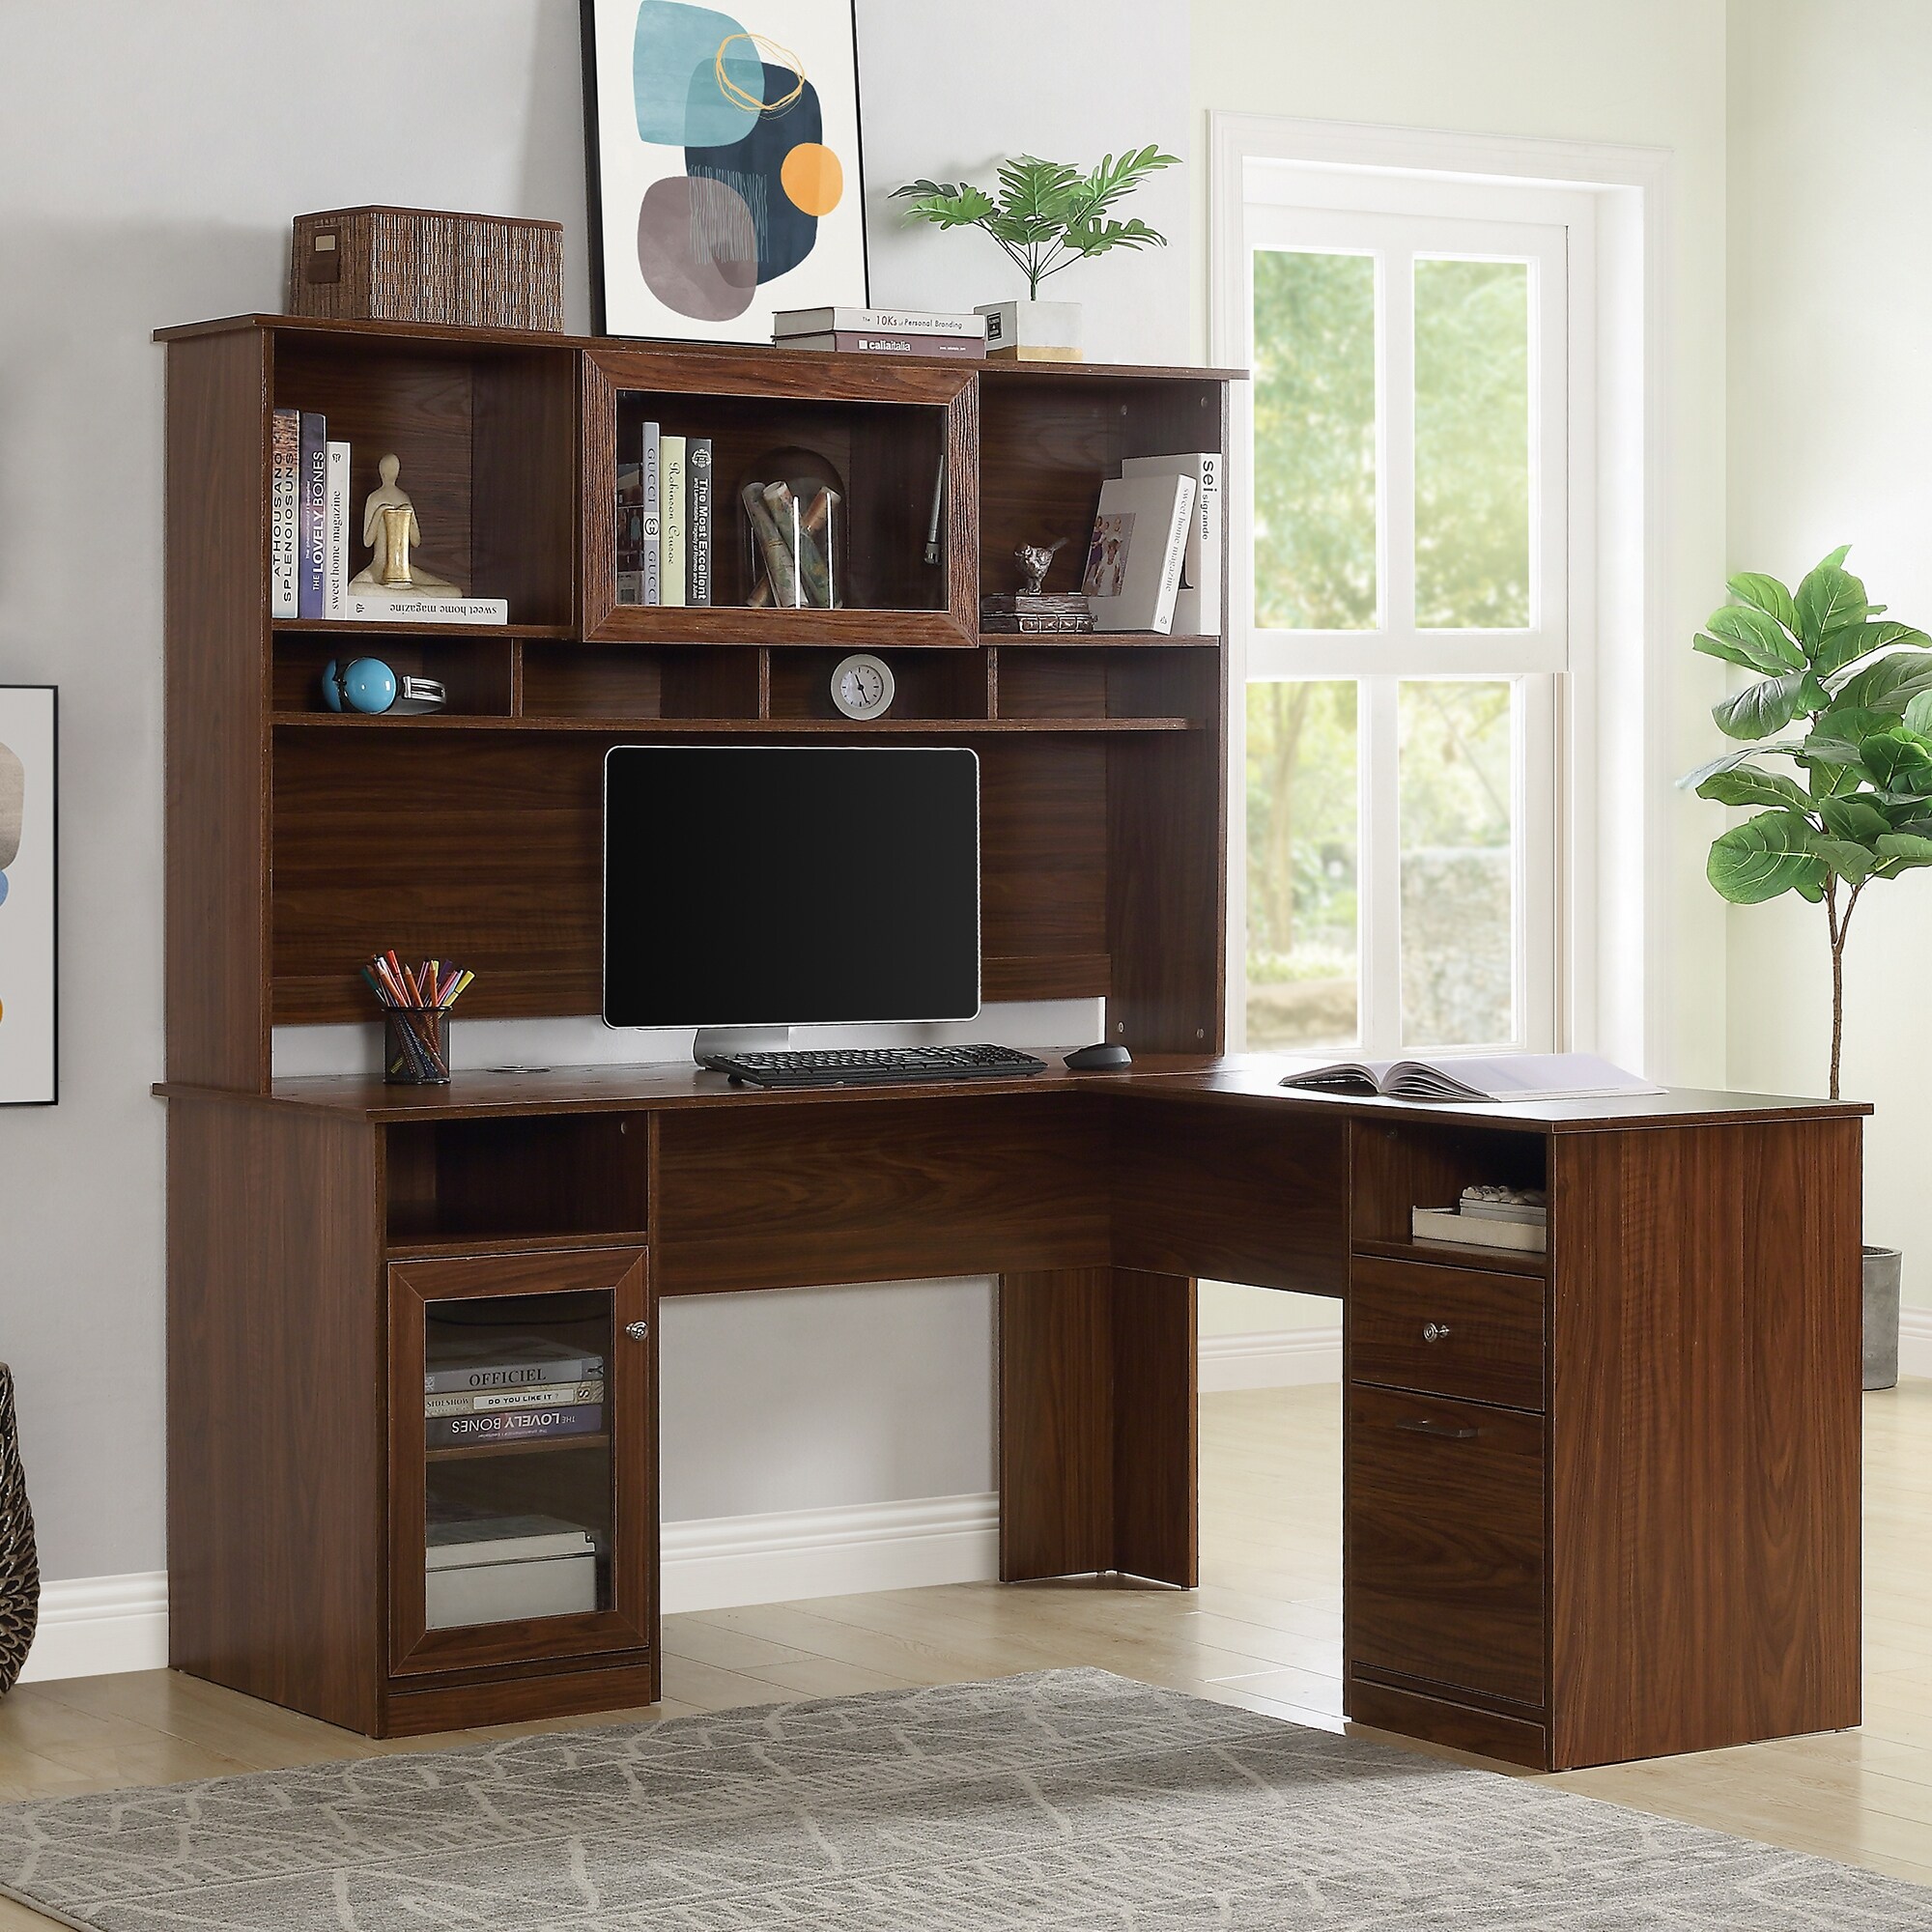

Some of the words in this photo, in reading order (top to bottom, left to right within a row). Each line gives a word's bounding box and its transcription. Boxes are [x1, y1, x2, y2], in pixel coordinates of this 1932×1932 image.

[876, 315, 897, 327] 10Ks
[904, 318, 933, 327] Personal
[935, 320, 963, 330] Branding
[312, 451, 325, 507] BONES
[647, 448, 656, 503] GUCCI
[1203, 460, 1218, 492] sei
[668, 461, 681, 521] Robinson
[698, 478, 708, 503] The
[1179, 487, 1190, 515] sweet
[332, 490, 343, 544] magazine
[698, 506, 708, 538] Most
[1174, 517, 1186, 544] home
[312, 510, 324, 573] LOVELY
[329, 546, 340, 576] home
[697, 541, 708, 600] Excellent
[1164, 546, 1179, 593] magazine
[331, 580, 340, 610] sweet
[389, 602, 437, 612] magazine
[469, 604, 497, 615] sweet
[439, 605, 467, 616] home
[469, 1368, 547, 1387] OFFICIEL
[451, 1417, 501, 1435] BONES
[504, 1412, 560, 1429] LOVELY
[561, 1415, 576, 1424] THE
